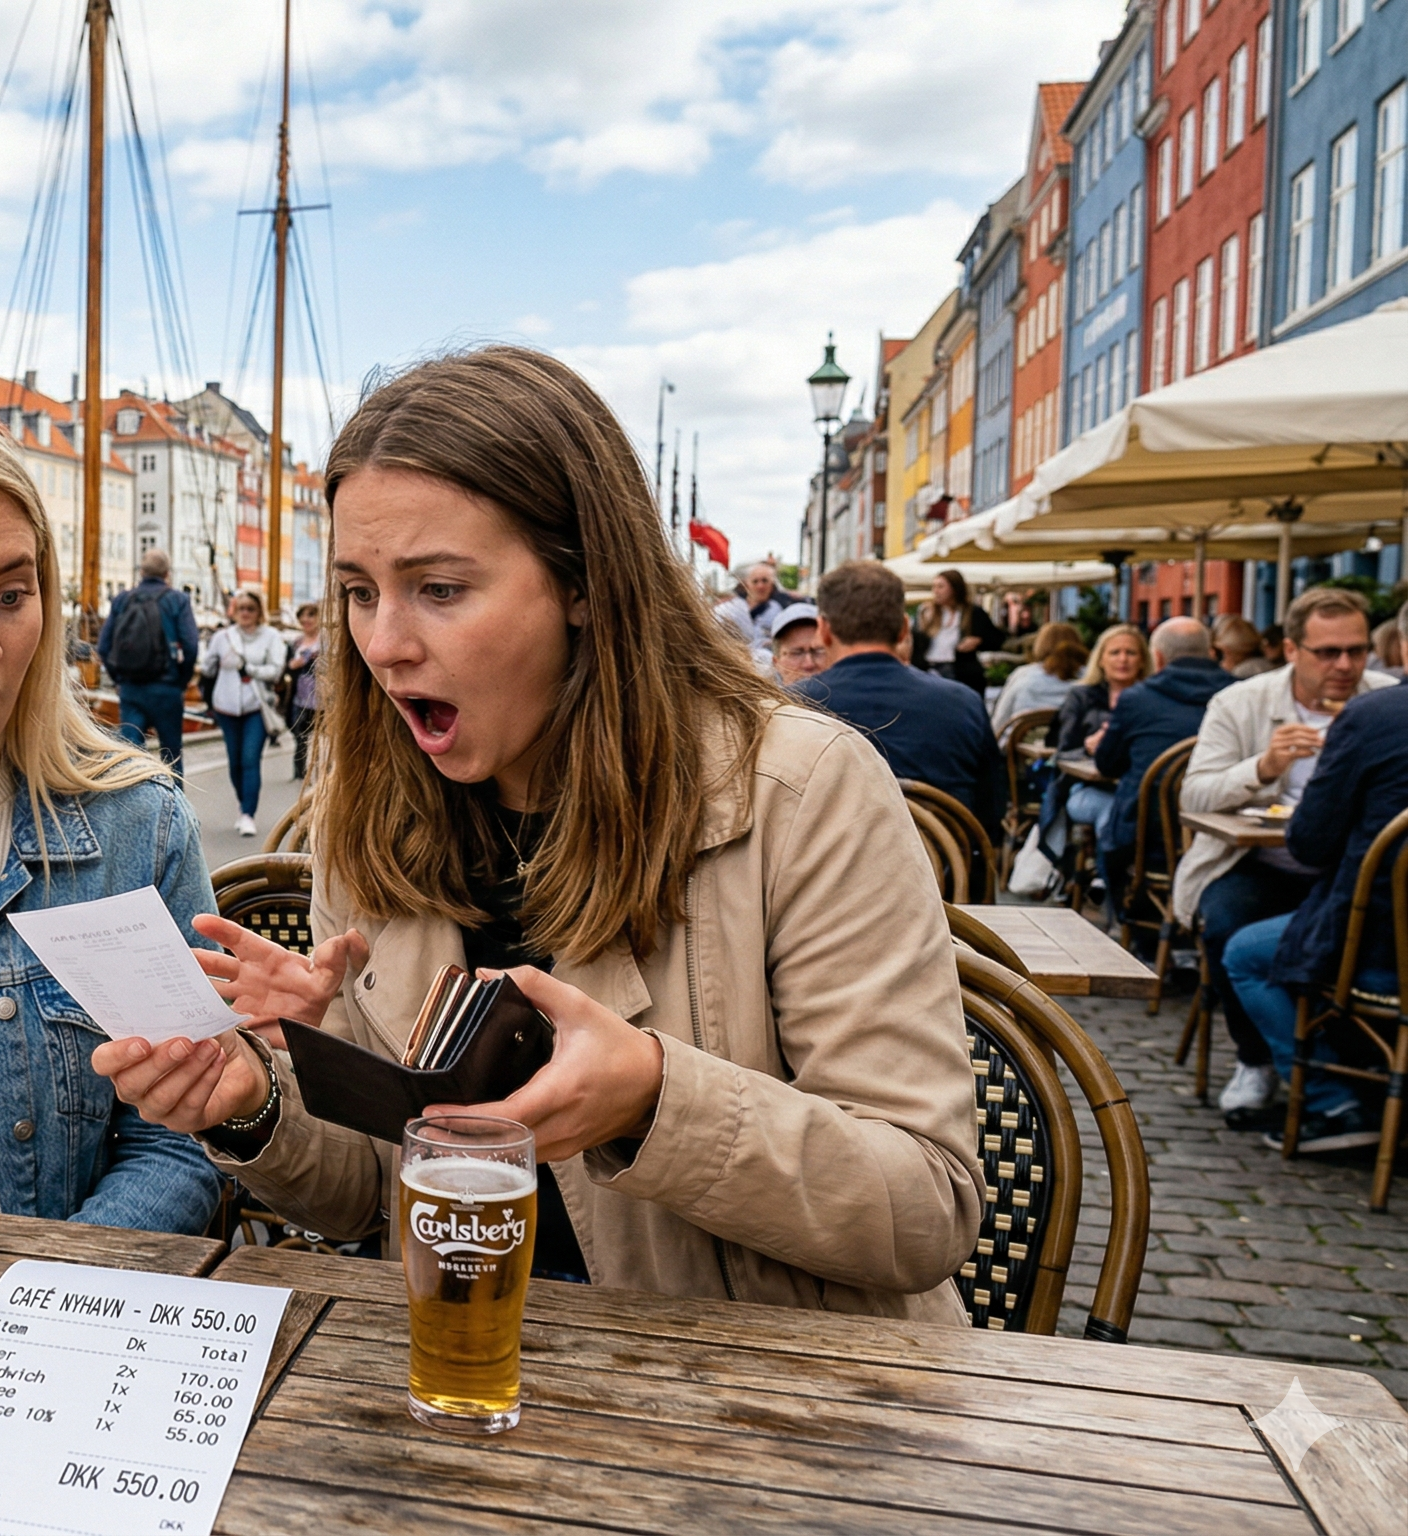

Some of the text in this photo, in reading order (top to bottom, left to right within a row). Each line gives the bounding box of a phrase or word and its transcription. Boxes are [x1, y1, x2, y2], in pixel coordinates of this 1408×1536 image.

[410, 1200, 527, 1245] Carlsberg
[9, 1286, 56, 1310] CAFÉ
[59, 1292, 126, 1319] NYHAVN
[149, 1303, 185, 1326] DKK
[191, 1308, 257, 1334] 550.00
[201, 1346, 248, 1363] Total
[116, 1364, 138, 1379] 2x
[179, 1372, 239, 1391] 170.00
[111, 1382, 130, 1396] 1x
[173, 1390, 233, 1409] 160.00
[103, 1399, 123, 1414] 1x
[173, 1409, 226, 1428] 65.00
[95, 1417, 115, 1432] 1x
[165, 1426, 219, 1446] 55.00
[58, 1462, 105, 1490] DKK
[113, 1470, 200, 1503] 550.00
